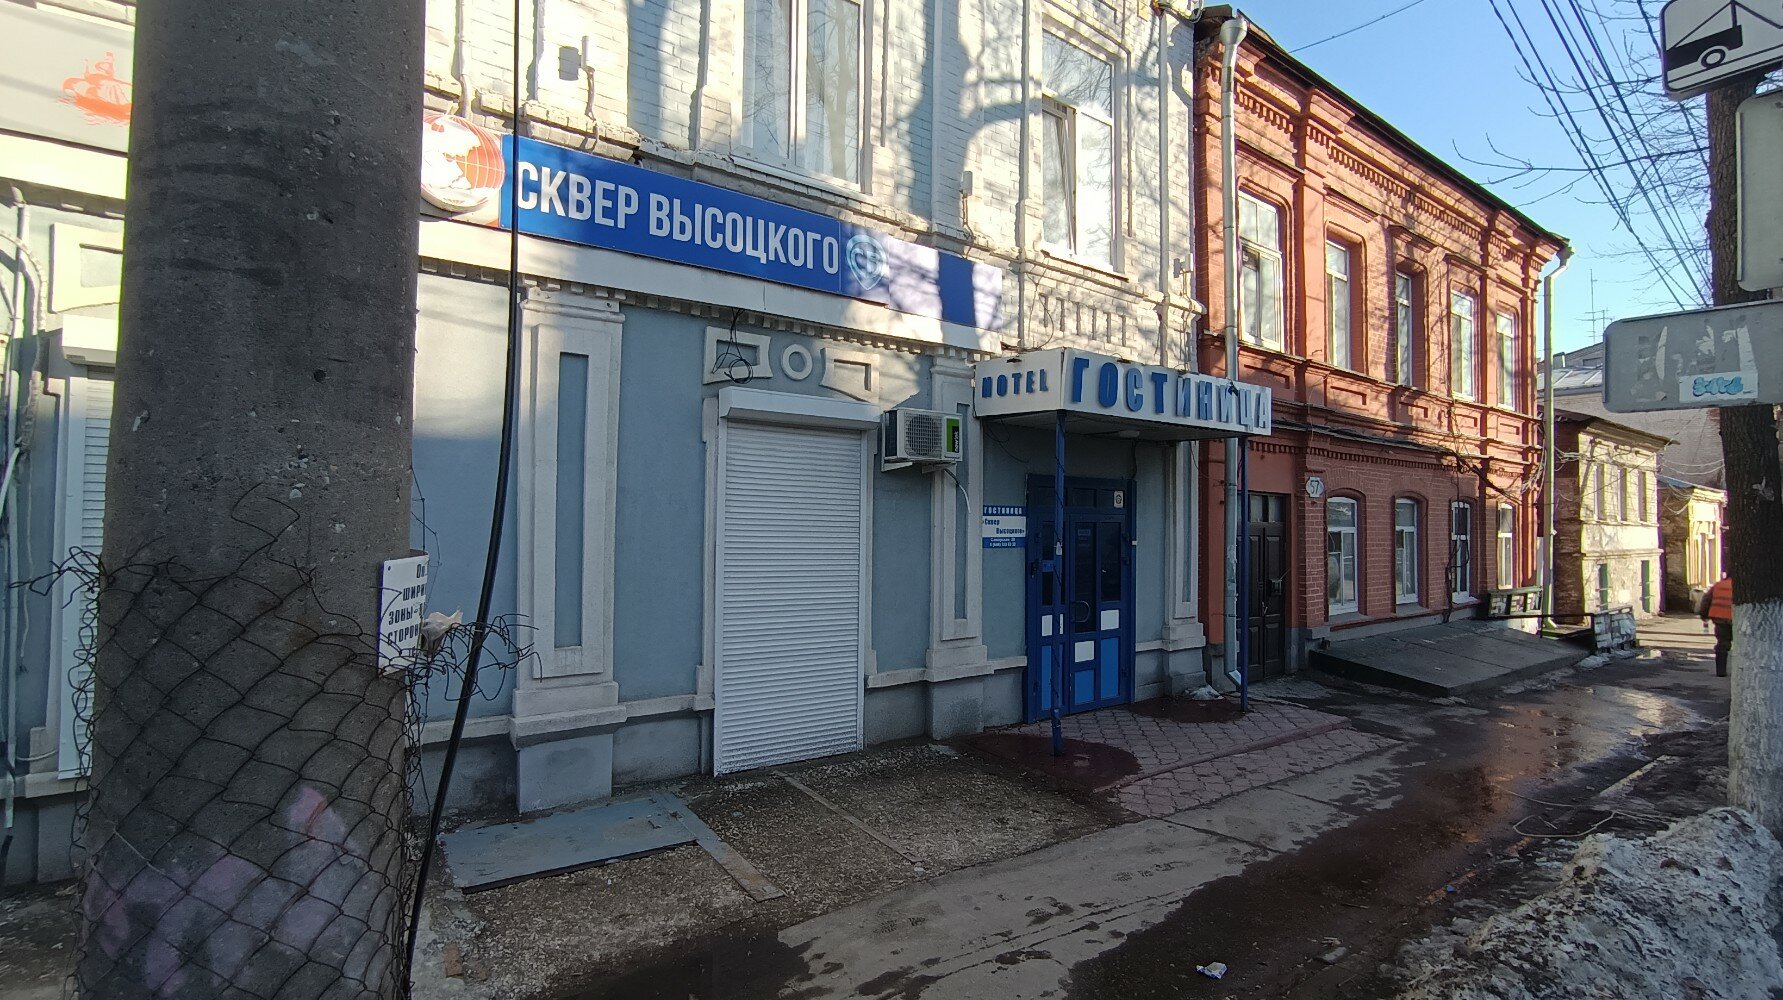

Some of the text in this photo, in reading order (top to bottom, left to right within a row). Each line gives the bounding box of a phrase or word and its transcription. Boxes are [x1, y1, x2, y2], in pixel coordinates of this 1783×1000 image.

[517, 161, 839, 275] СКВЕР ВЫСОЦКОГО
[982, 369, 1049, 398] HOTEL
[1072, 357, 1268, 431] ГОСТИНИЦА
[1310, 480, 1320, 494] 57
